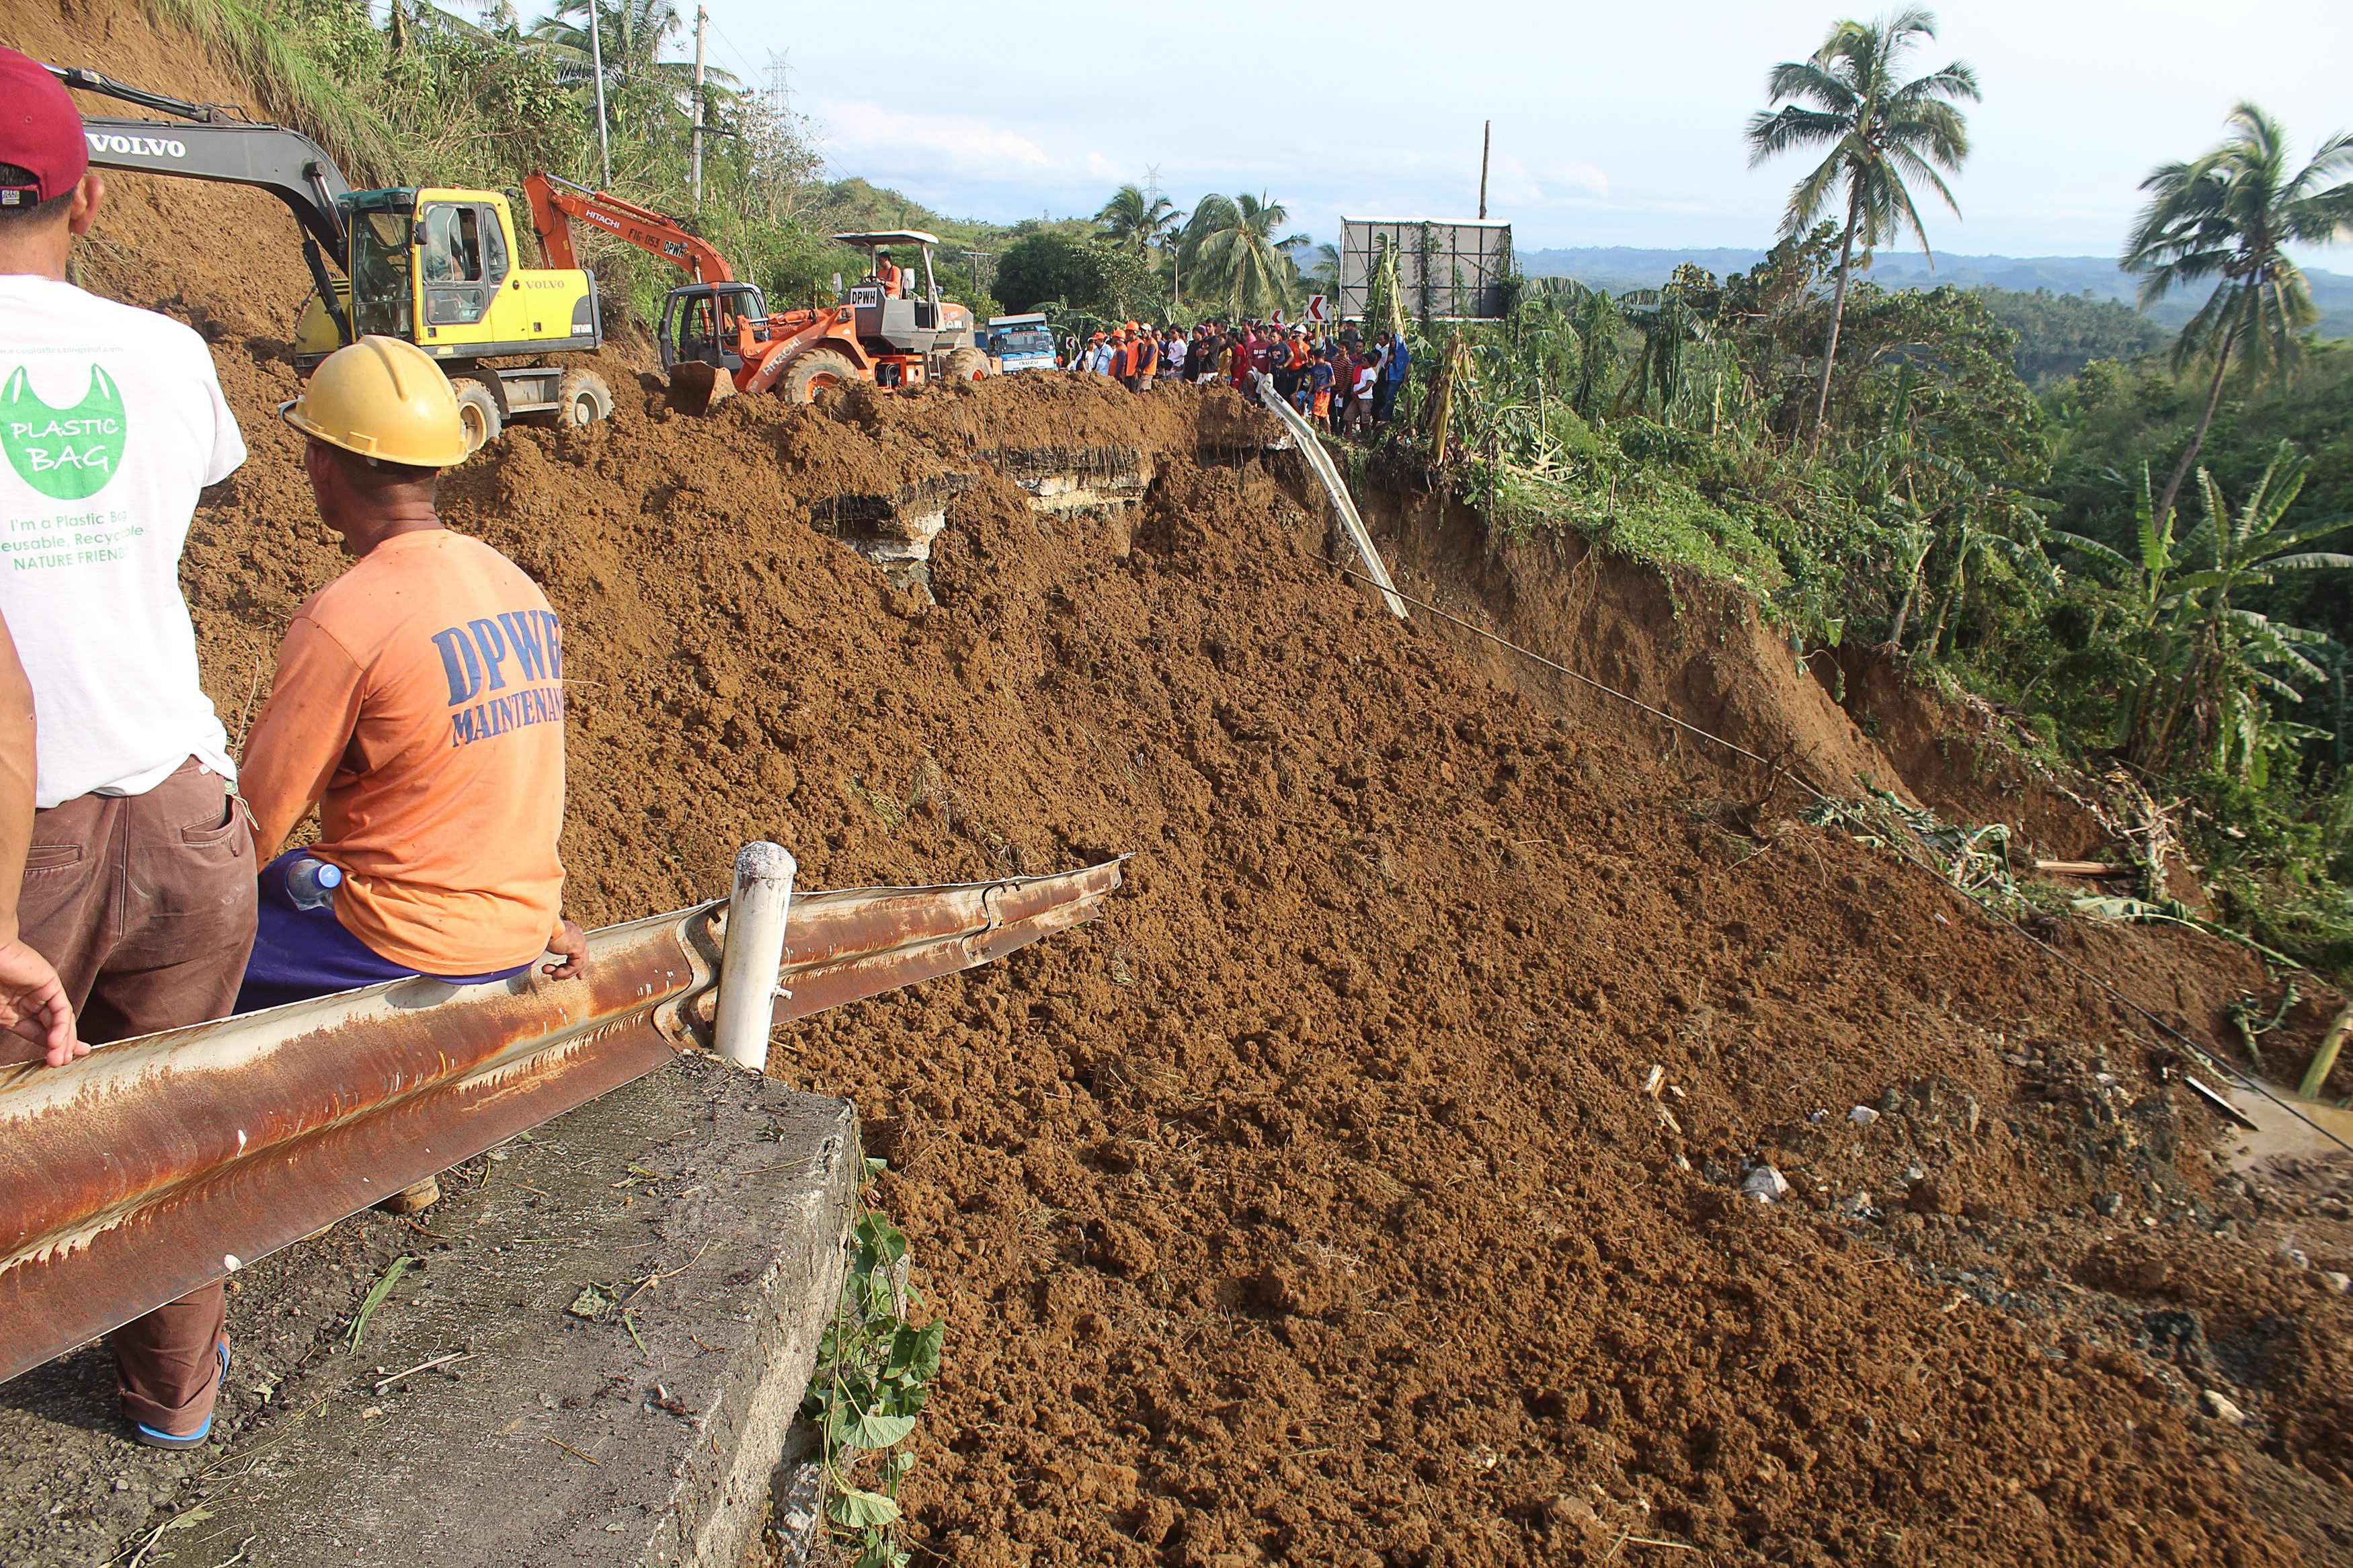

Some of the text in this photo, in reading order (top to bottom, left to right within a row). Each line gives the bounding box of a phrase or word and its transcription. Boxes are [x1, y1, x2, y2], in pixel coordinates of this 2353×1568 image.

[84, 132, 186, 158] VOLVO
[586, 209, 621, 229] HITACHI
[664, 241, 684, 258] DPWH
[526, 280, 565, 289] VOLVO
[852, 290, 875, 304] DPWH
[762, 337, 802, 376] HITACHI
[11, 418, 119, 439] PLASTIC
[25, 445, 109, 472] BAG
[11, 519, 36, 531] I'm
[41, 520, 51, 529] a
[56, 513, 105, 528] Plastic
[0, 536, 71, 552] eusable,
[13, 554, 74, 571] NATURE
